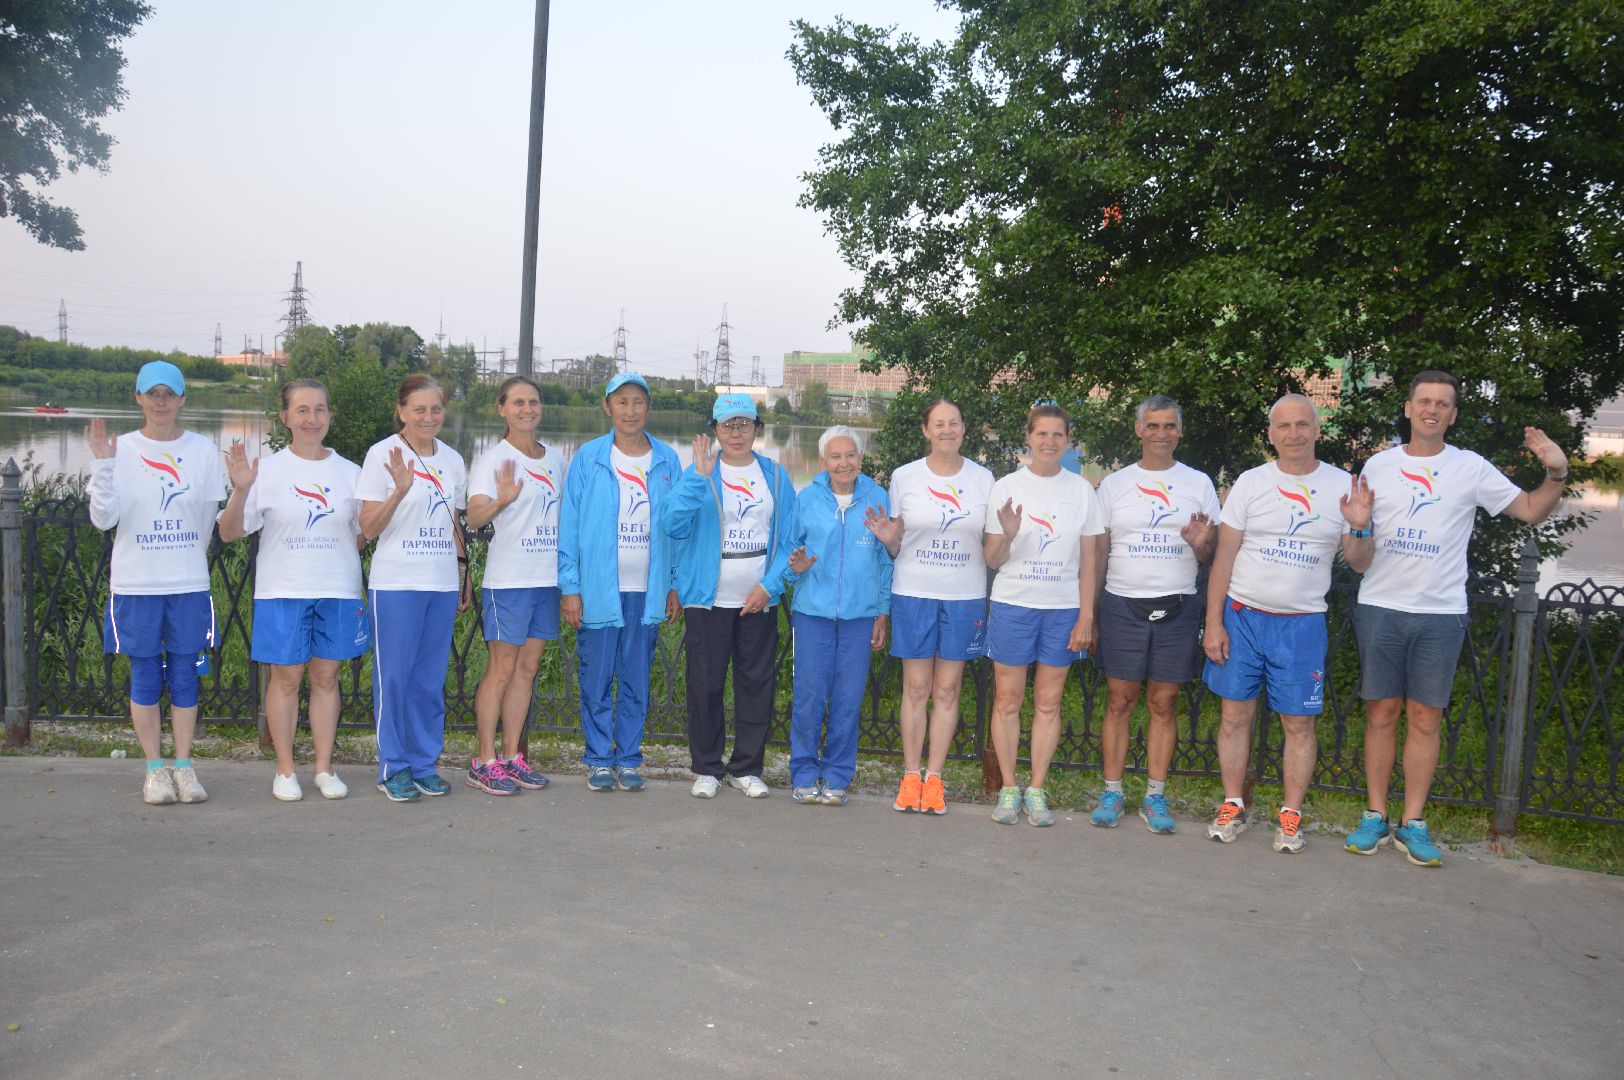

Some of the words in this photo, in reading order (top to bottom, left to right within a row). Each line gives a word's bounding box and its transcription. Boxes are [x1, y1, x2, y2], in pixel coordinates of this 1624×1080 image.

[153, 519, 183, 531] БЕГ
[536, 525, 560, 536] БЕГ
[620, 522, 647, 533] БЕГ
[136, 531, 199, 544] ГАРМОНИИ
[419, 527, 445, 538] БЕГ
[728, 529, 755, 539] БЕГ
[1142, 533, 1171, 543] БЕГ
[1397, 527, 1427, 540] БЕГ
[521, 538, 559, 547] ГАРМОН
[617, 534, 651, 543] РМОНИ
[1277, 537, 1308, 551] БЕГ
[723, 540, 768, 551] РМОНИИ
[931, 539, 960, 550] БЕГ
[1128, 545, 1184, 555] ГАРМОНИИ
[1383, 538, 1441, 554] ГАРМОНИИ
[916, 549, 971, 562] ГАРМОНИИ
[1031, 566, 1051, 575] БЕГ
